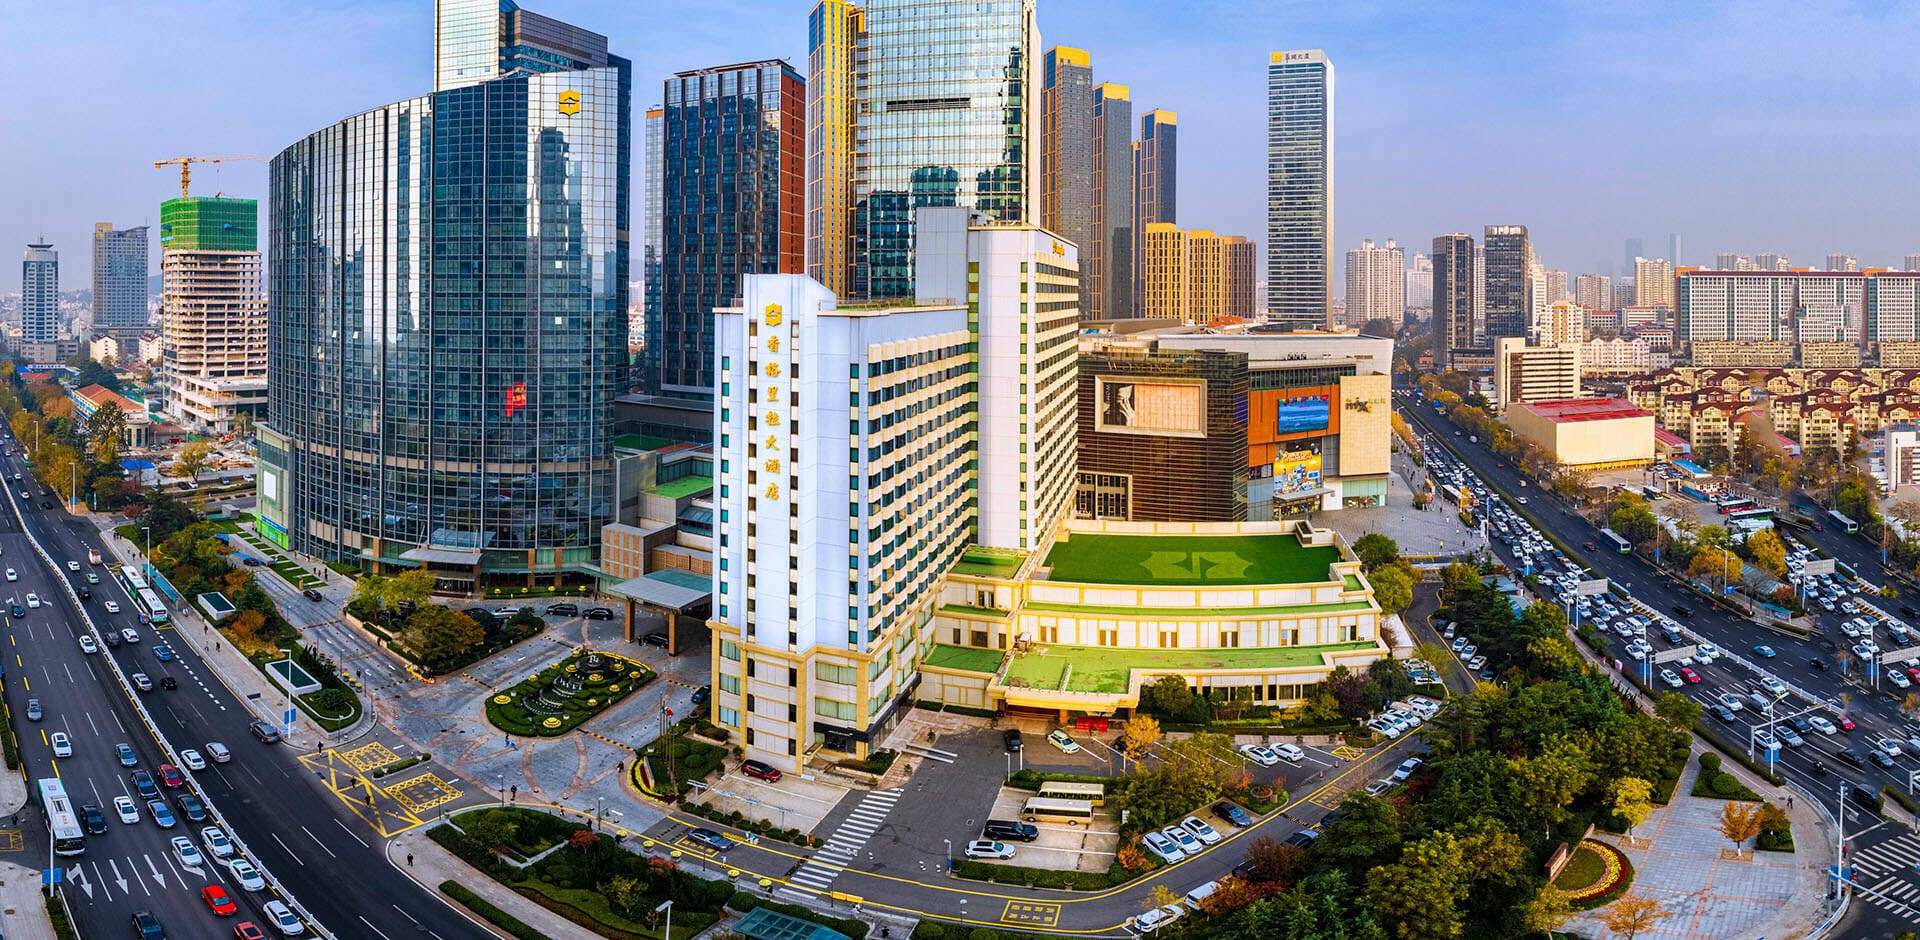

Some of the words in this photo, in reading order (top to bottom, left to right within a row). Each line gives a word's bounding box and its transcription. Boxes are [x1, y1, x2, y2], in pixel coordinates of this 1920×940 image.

[765, 335, 781, 500] 香格里拉大酒店
